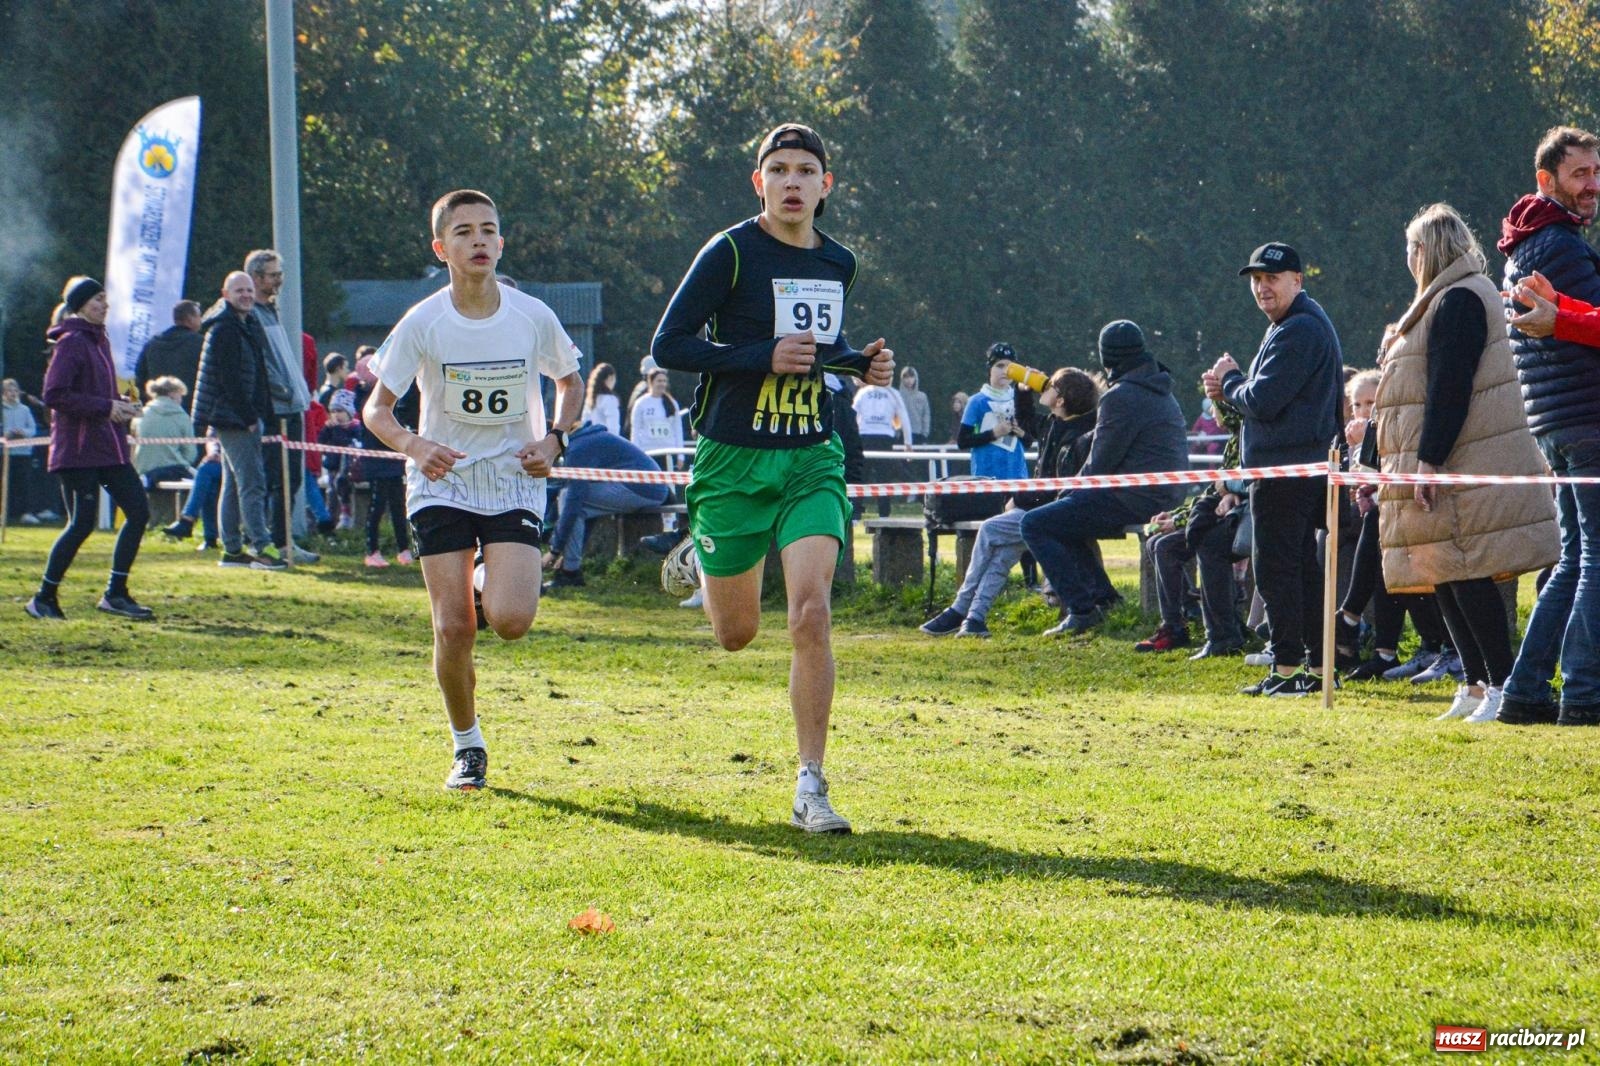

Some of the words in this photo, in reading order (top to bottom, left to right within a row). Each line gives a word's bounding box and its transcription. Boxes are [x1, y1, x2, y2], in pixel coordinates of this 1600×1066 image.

[792, 302, 831, 331] 95
[461, 389, 509, 414] 86
[752, 410, 823, 435] GOING
